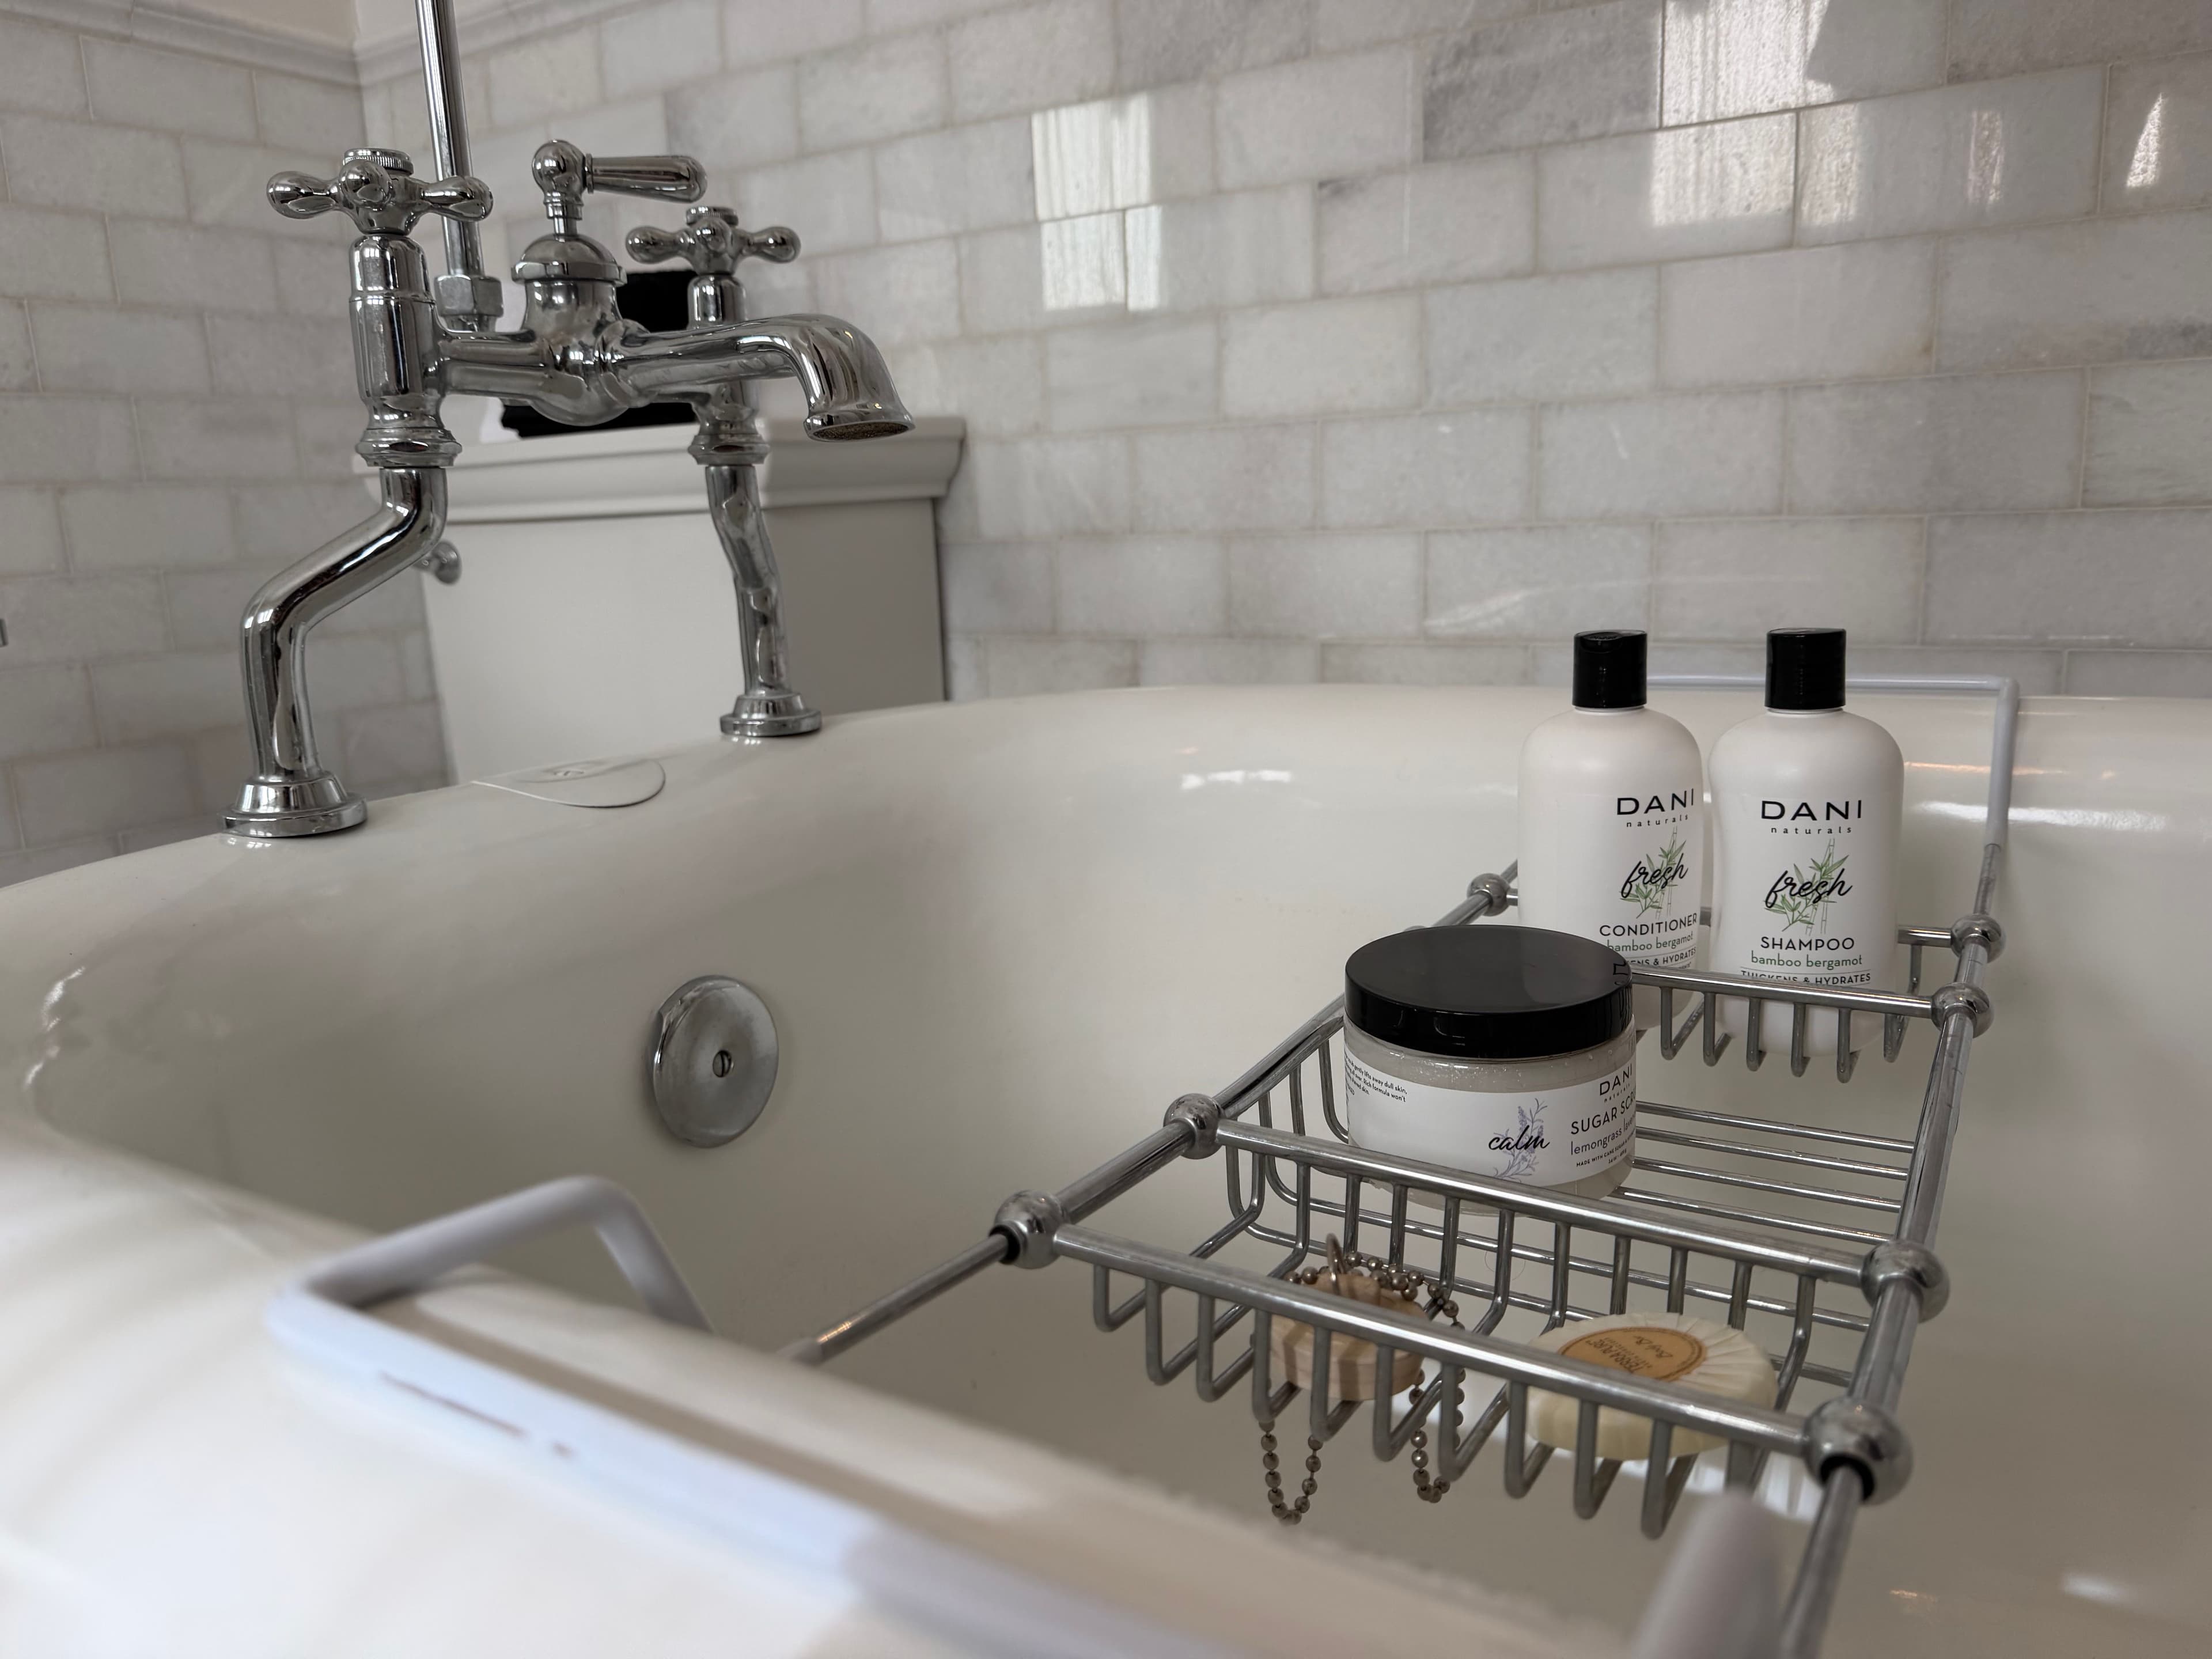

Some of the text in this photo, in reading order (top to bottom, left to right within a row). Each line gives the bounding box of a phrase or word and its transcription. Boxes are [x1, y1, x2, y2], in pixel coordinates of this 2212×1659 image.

[1617, 788, 1694, 815] DANI
[1761, 800, 1862, 821] DANI
[1626, 815, 1688, 827] naturals
[1771, 826, 1852, 835] naturals
[1620, 853, 1688, 899] fresh
[1765, 868, 1853, 908] fresh
[1599, 912, 1697, 936] CONDITIONER
[1607, 931, 1693, 952] bamboo bergamot
[1760, 936, 1855, 950] SHAMPOO
[1653, 958, 1659, 966] &
[1662, 946, 1696, 964] HYDRATES
[1751, 950, 1862, 971] bamboo bergamot
[1815, 973, 1871, 986] HYDRATES
[1372, 1077, 1384, 1087] away
[1384, 1081, 1393, 1090] dull
[1395, 1085, 1407, 1095] skin,
[1600, 1063, 1632, 1096] DANI
[1373, 1083, 1390, 1097] formula
[1391, 1093, 1406, 1103] won't
[1571, 1107, 1617, 1135] SUGAR
[1620, 1088, 1635, 1114] SCR
[1488, 1124, 1550, 1151] calm
[1571, 1127, 1622, 1156] lemongrass
[1576, 1158, 1590, 1168] MADE
[1592, 1153, 1603, 1162] WITH
